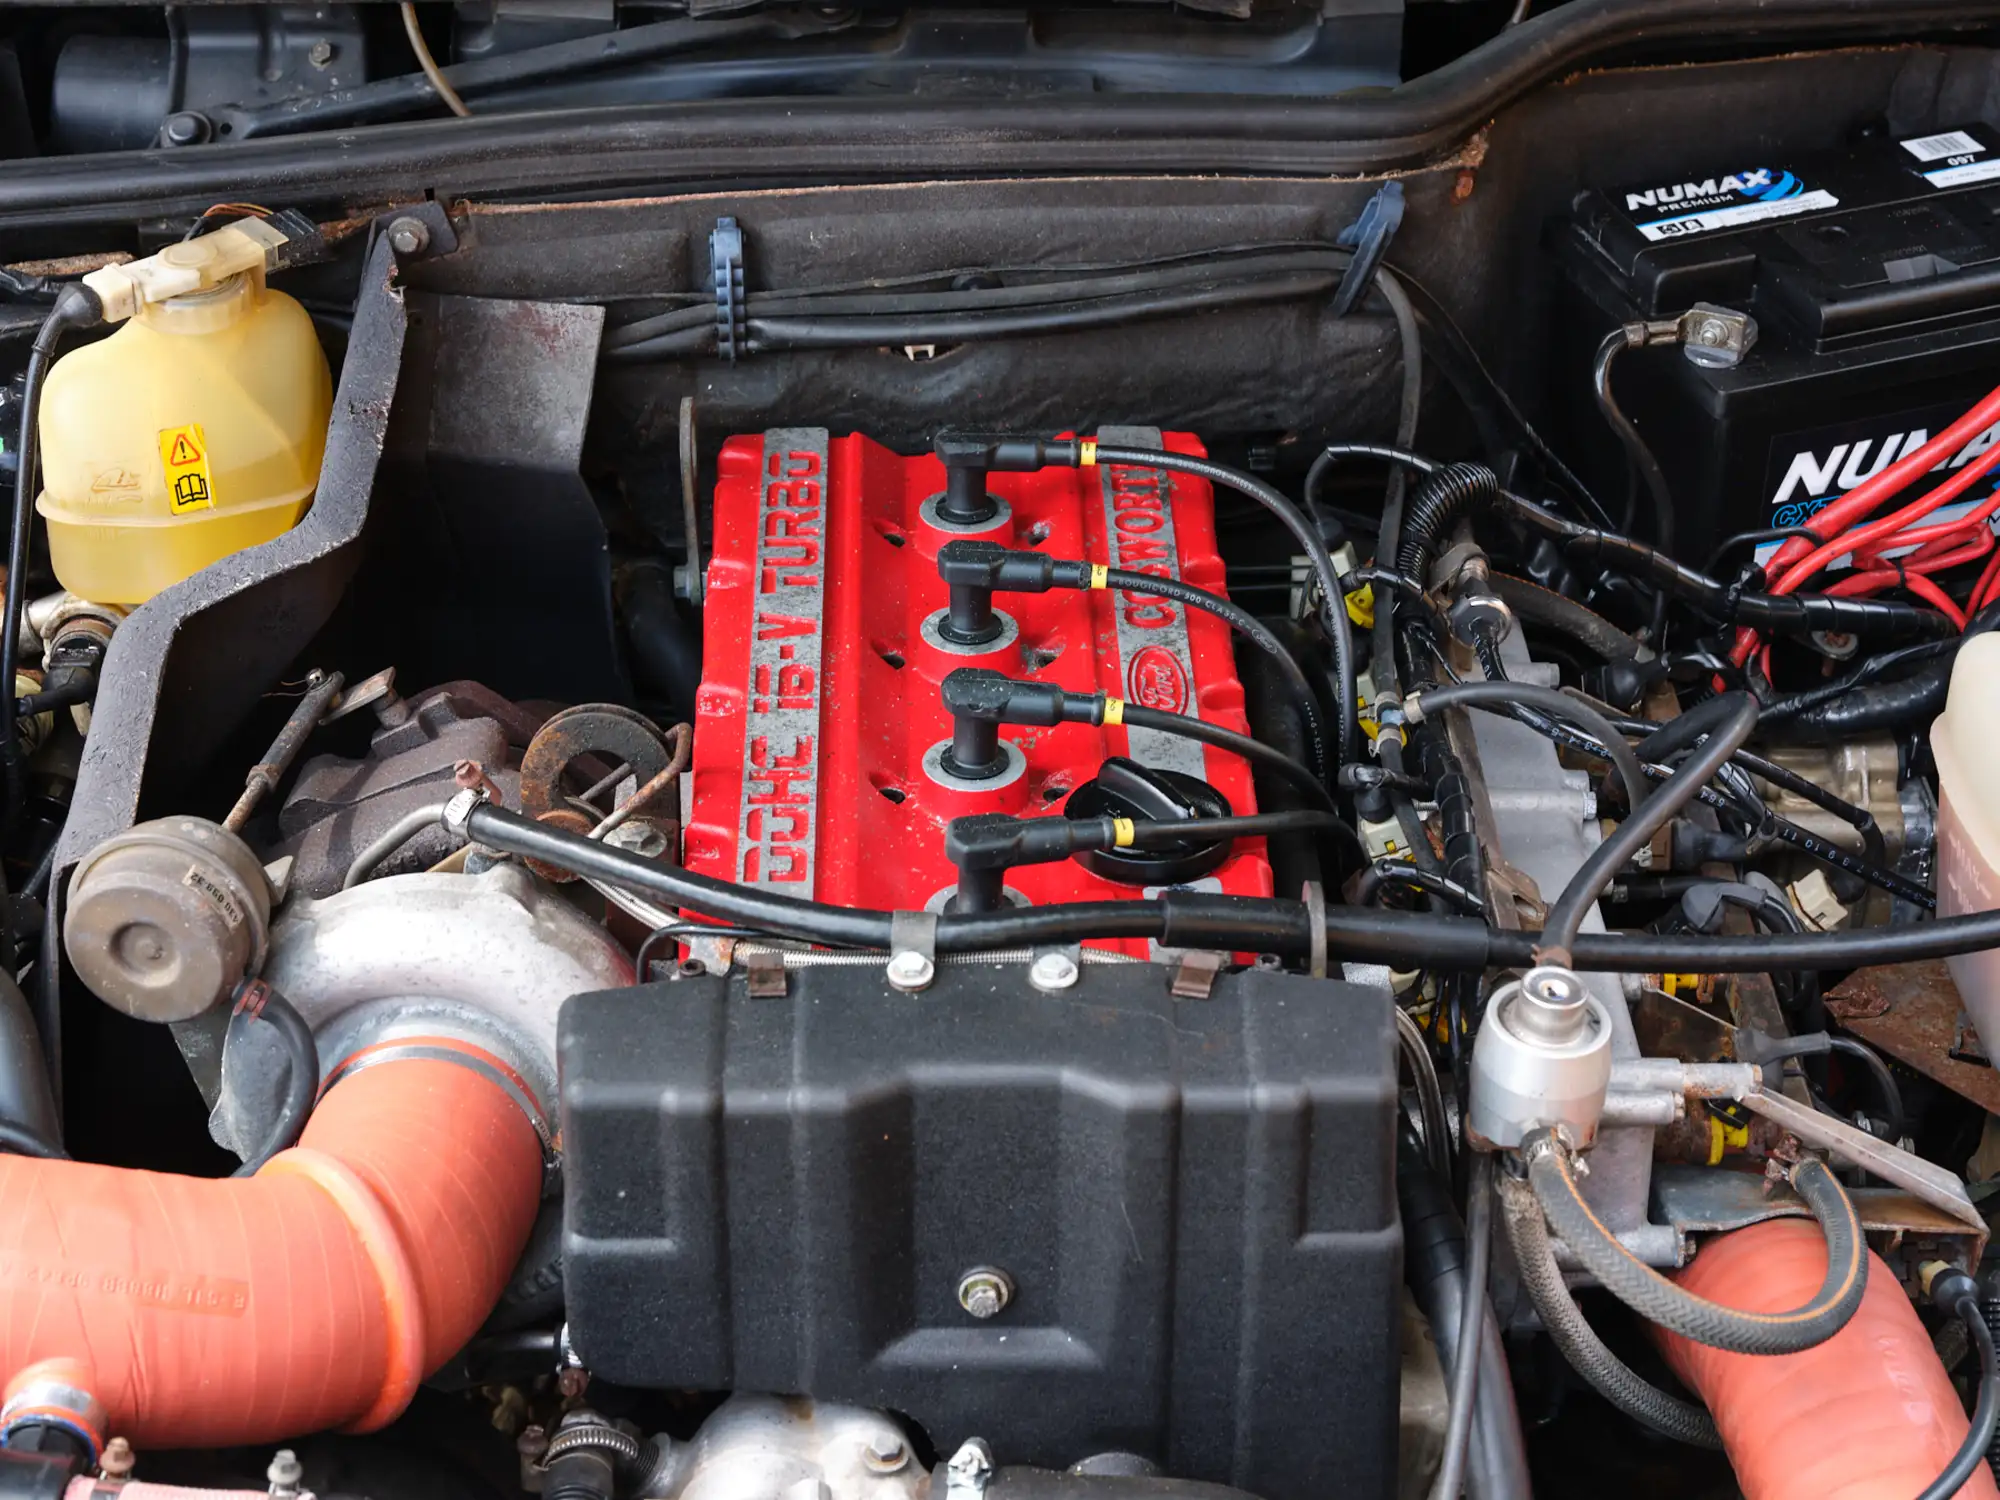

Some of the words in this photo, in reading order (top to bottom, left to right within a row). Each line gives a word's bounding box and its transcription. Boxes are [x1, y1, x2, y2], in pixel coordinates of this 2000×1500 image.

[1946, 154, 1976, 167] 097
[1625, 167, 1773, 211] NUMAX
[1657, 193, 1735, 214] PREMIUM
[759, 450, 821, 595] TURBO
[1109, 464, 1177, 629] COWORT
[1117, 577, 1182, 599] BOUGICORD
[1183, 591, 1203, 605] 500
[1204, 599, 1237, 622] CLASS
[752, 611, 818, 715] 16-V
[1138, 657, 1177, 710] Ford
[742, 734, 813, 884] DOHC
